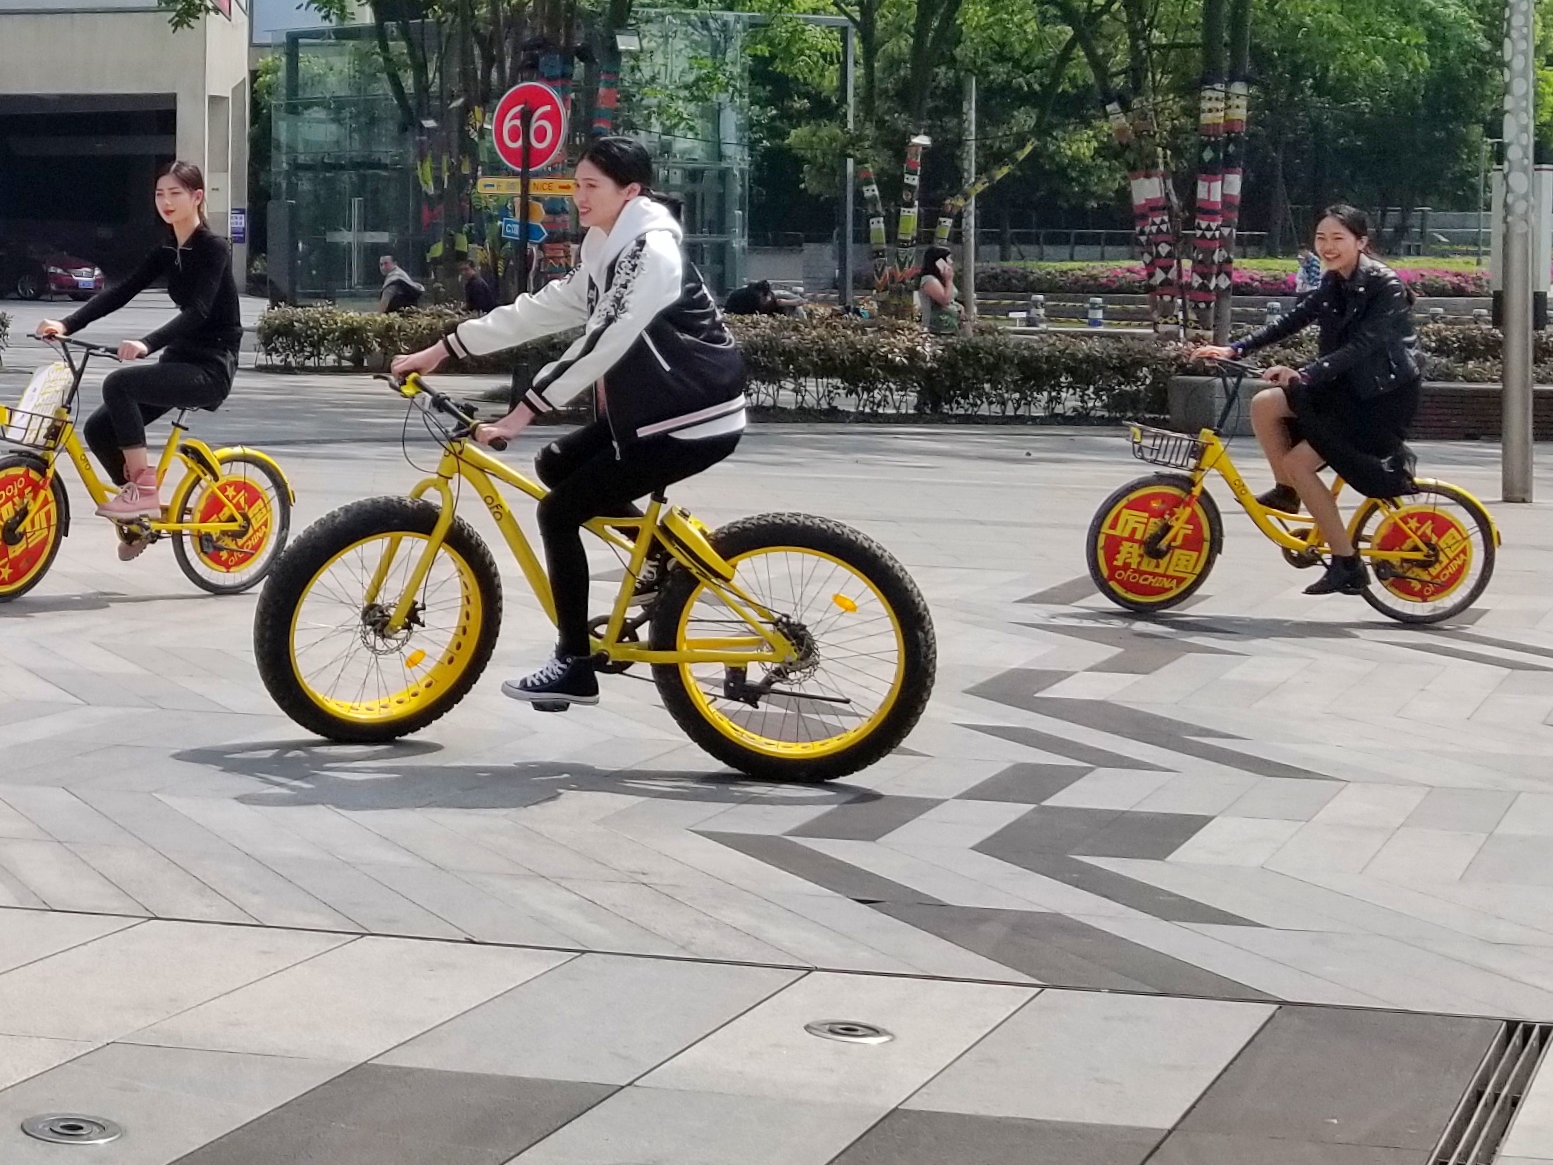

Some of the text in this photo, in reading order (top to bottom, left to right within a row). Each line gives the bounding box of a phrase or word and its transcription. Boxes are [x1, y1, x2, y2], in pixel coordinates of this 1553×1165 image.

[502, 104, 553, 149] 66
[484, 495, 503, 522] ofo
[1139, 574, 1177, 590] CHINA
